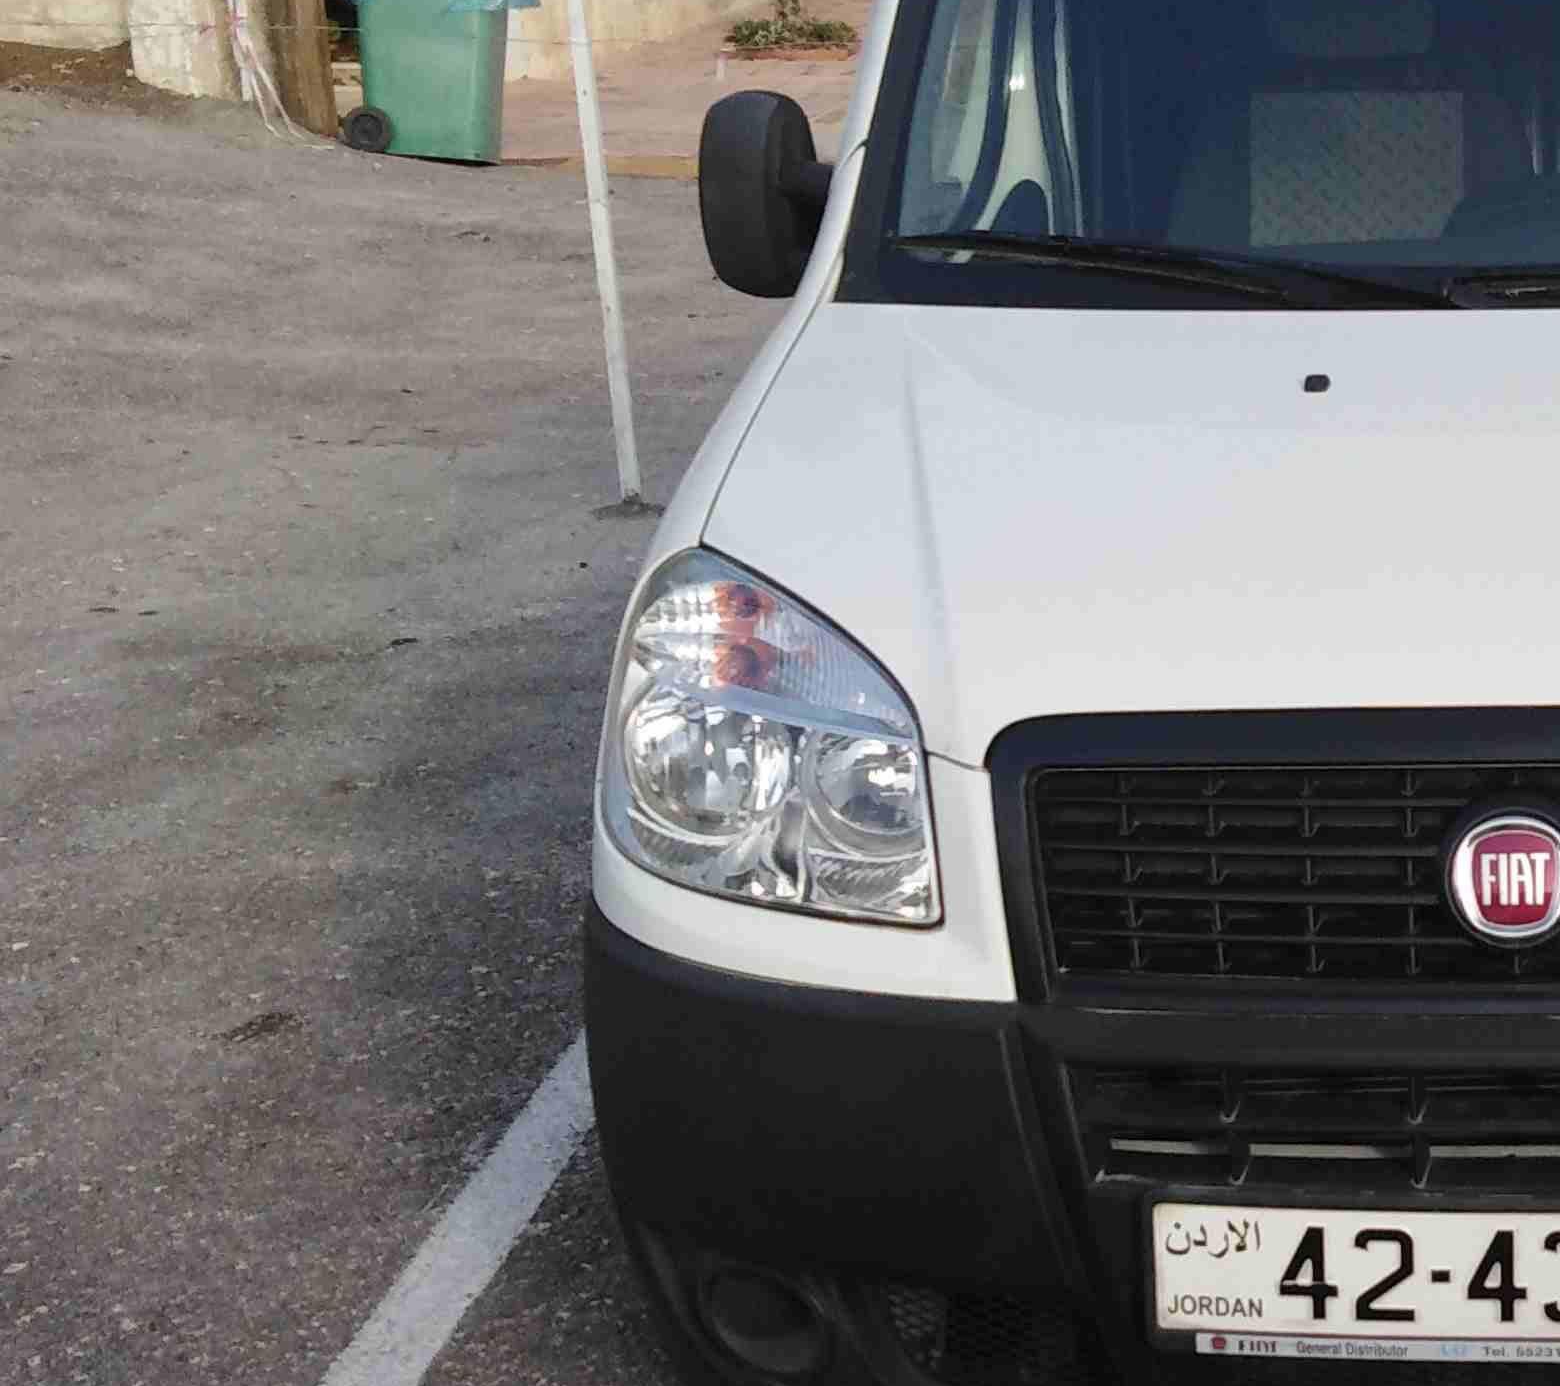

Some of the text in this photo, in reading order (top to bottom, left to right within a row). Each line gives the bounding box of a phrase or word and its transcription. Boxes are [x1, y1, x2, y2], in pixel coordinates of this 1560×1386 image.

[1481, 852, 1551, 906] FIAT
[1167, 1294, 1264, 1318] JORDAN
[1296, 1341, 1409, 1357] General Distributor
